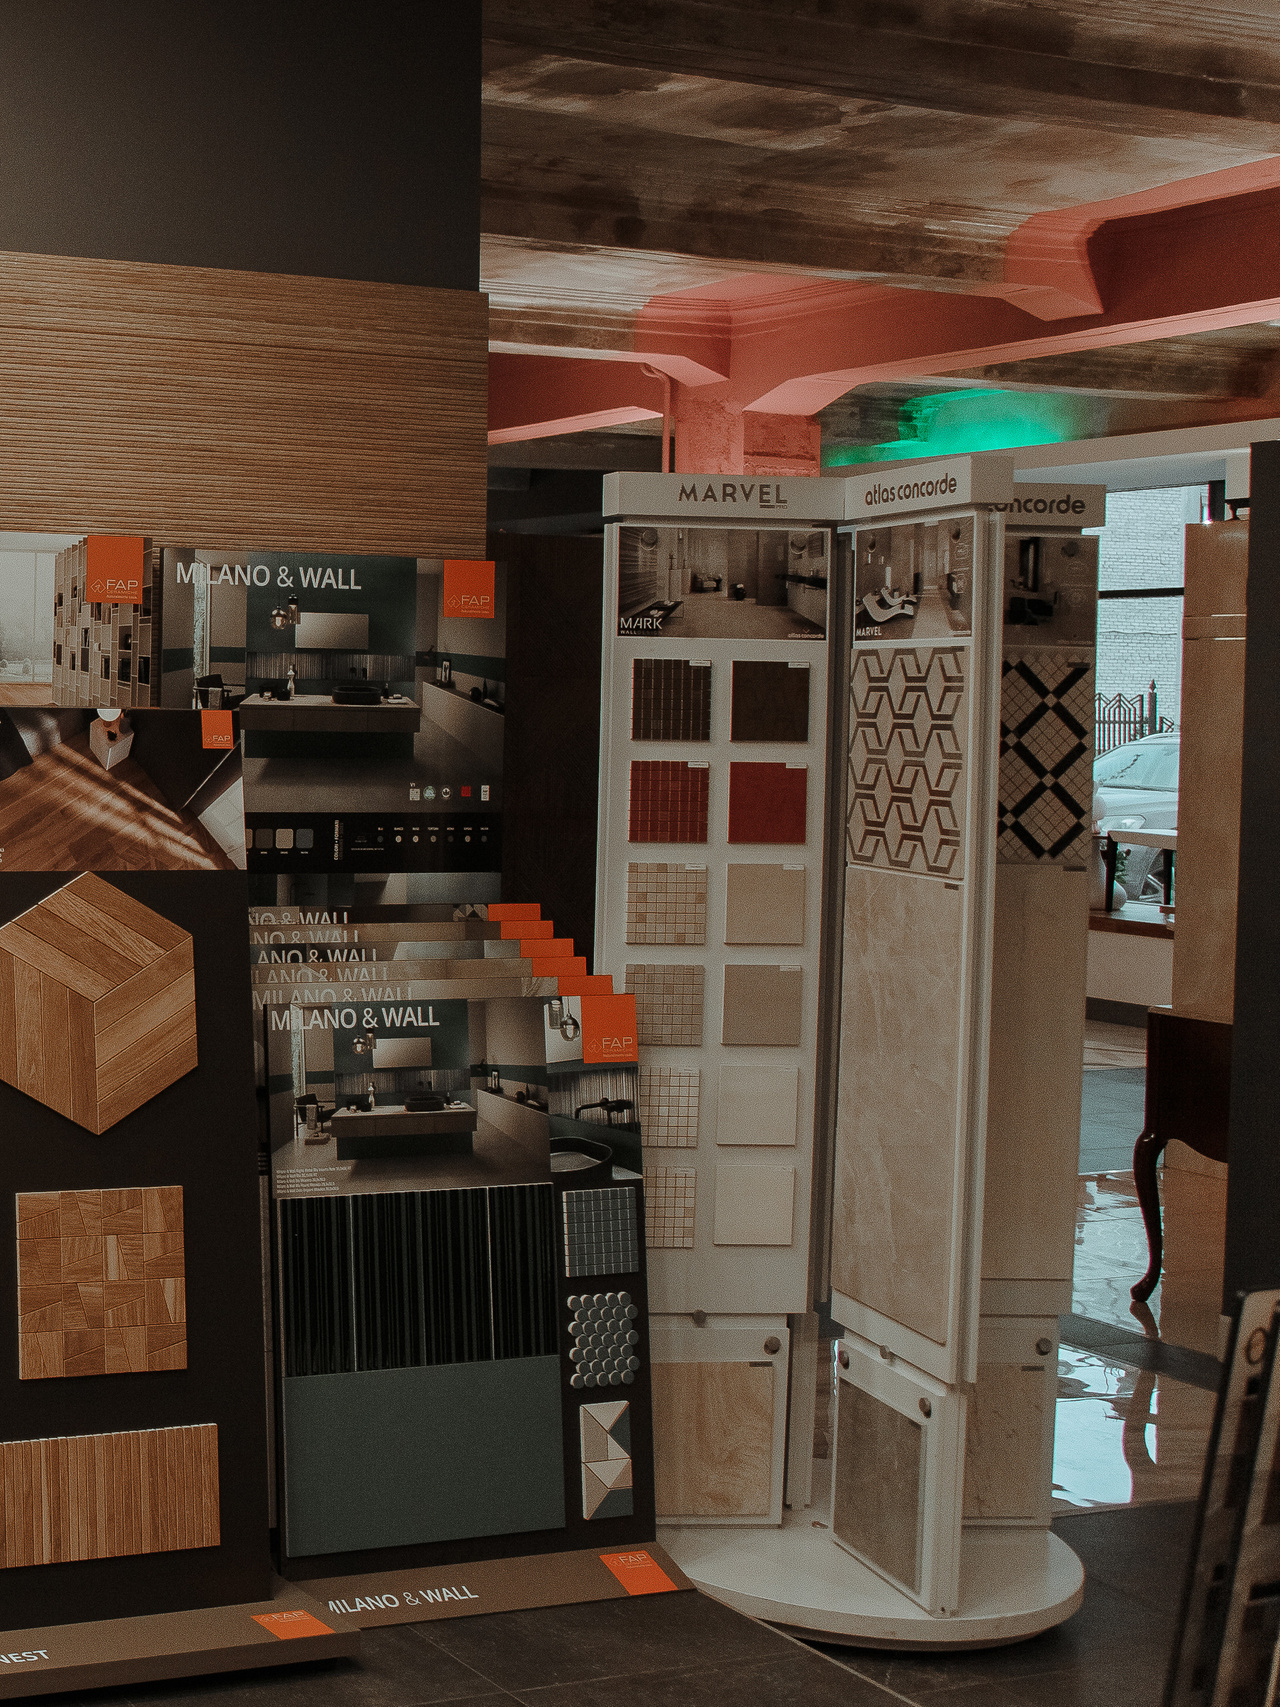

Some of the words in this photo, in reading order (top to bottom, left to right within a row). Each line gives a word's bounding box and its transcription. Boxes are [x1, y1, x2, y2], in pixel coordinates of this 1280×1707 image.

[678, 482, 788, 504] MARVEL
[865, 484, 895, 506] atlas
[897, 473, 957, 499] concorde
[277, 566, 294, 588] &
[298, 566, 362, 589] WALL
[106, 580, 138, 590] FAP
[461, 595, 490, 605] FAP
[620, 617, 662, 629] MARK
[856, 626, 882, 636] MARVEL
[308, 949, 323, 962] &
[318, 968, 333, 982] &
[343, 988, 357, 1002] &
[271, 1008, 357, 1030] MLANO
[362, 1008, 378, 1028] &
[382, 1006, 440, 1027] WALL
[602, 1037, 633, 1049] FAP
[618, 1554, 646, 1564] FAP
[403, 1592, 422, 1606] &
[419, 1585, 479, 1604] WALL
[271, 1611, 304, 1620] FAP
